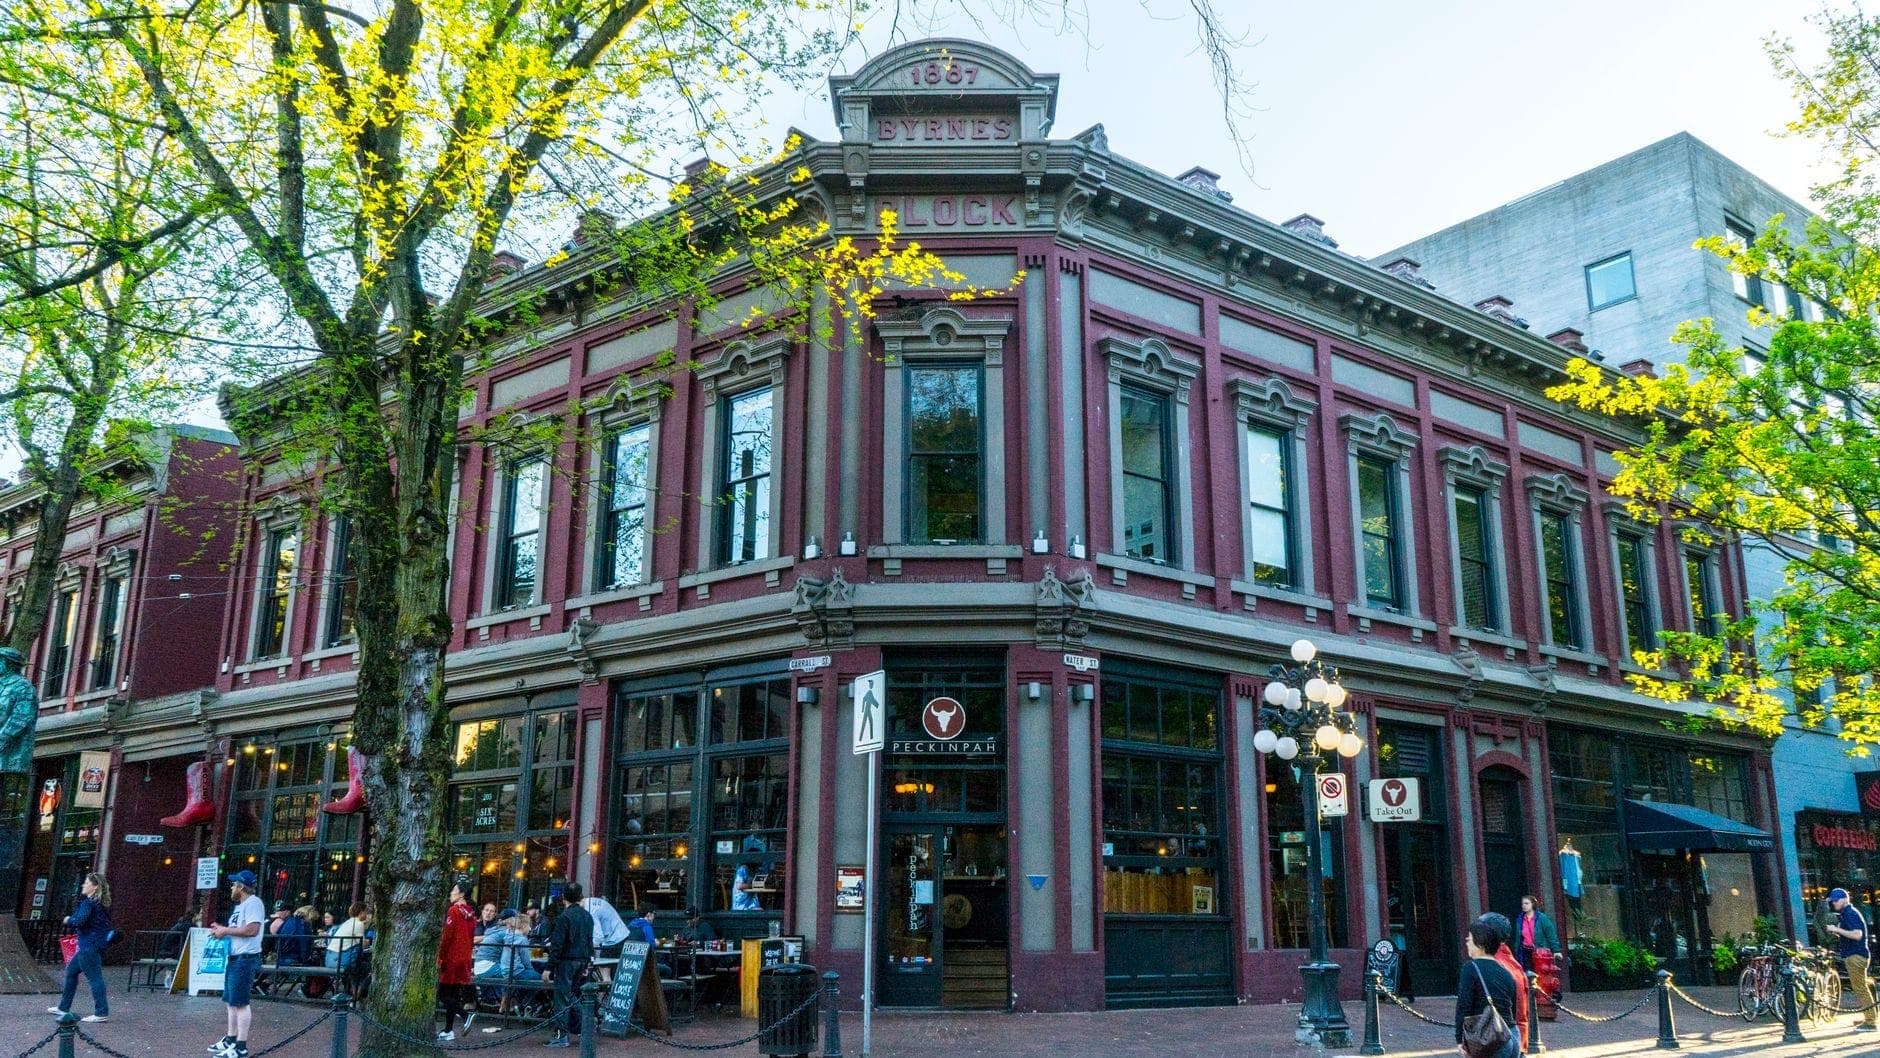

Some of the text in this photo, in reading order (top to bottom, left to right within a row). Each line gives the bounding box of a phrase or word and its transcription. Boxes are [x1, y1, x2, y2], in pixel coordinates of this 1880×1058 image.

[911, 62, 979, 85] 1887
[878, 117, 1012, 140] BYRNES
[893, 742, 995, 752] PECKINPAH
[1396, 807, 1413, 815] Out
[475, 816, 496, 826] ACRES
[619, 971, 634, 983] WITH
